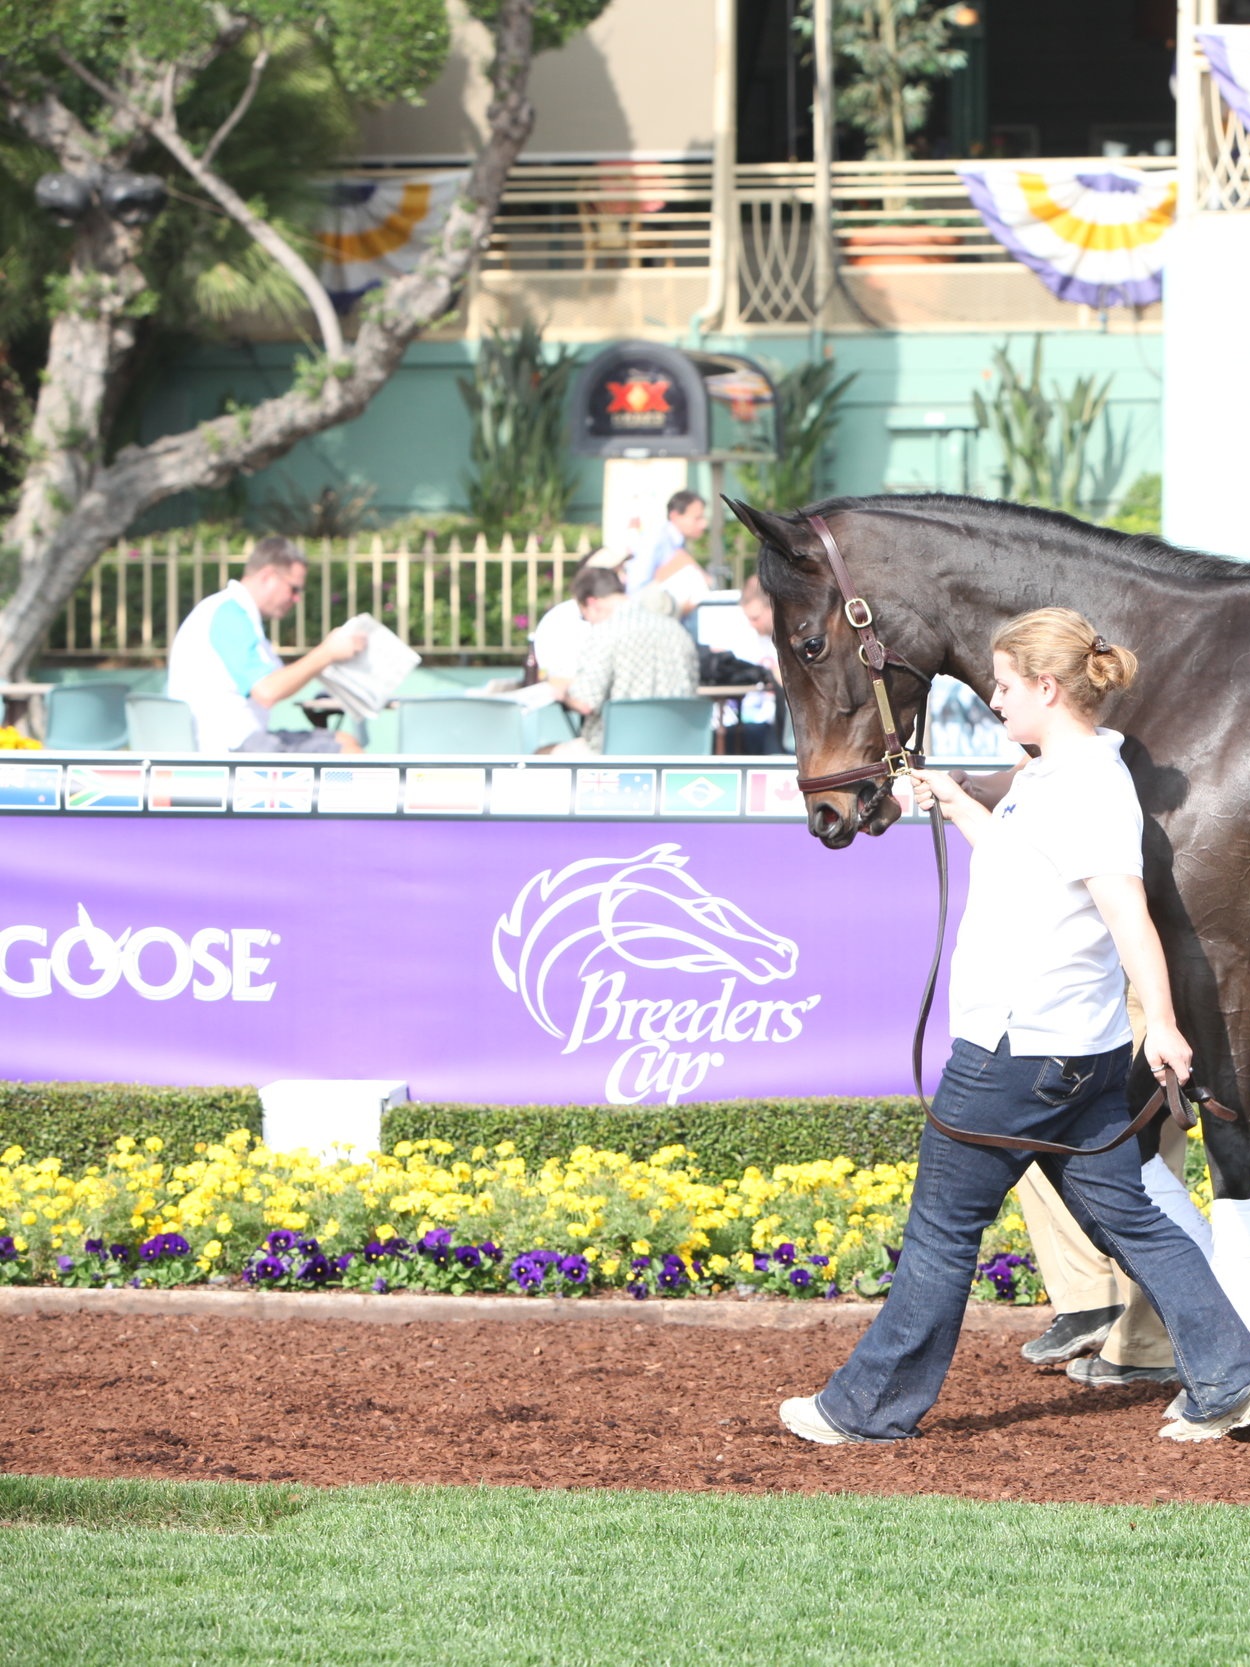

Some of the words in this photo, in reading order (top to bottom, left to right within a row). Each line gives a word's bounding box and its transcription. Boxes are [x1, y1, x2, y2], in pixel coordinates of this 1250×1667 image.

[0, 925, 278, 1002] GOOSE
[561, 969, 822, 1055] Breeders'
[605, 1038, 711, 1105] Cup
